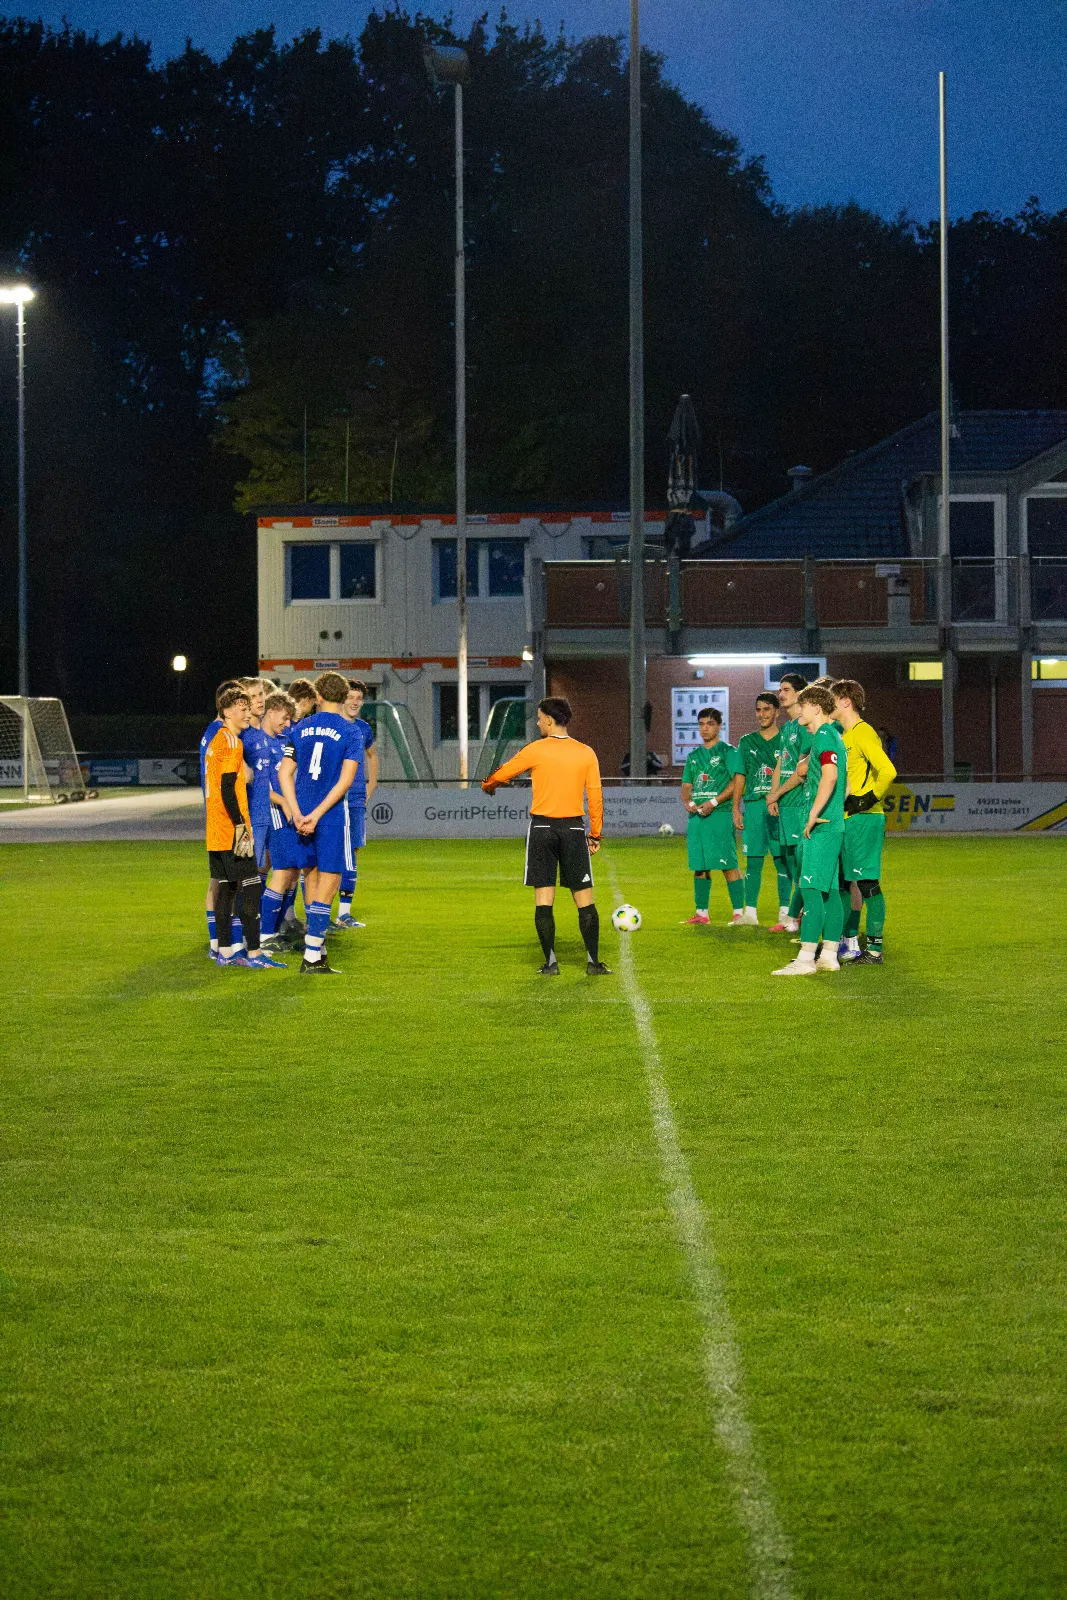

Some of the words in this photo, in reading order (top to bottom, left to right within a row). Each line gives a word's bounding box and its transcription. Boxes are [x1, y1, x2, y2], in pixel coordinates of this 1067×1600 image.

[309, 742, 324, 781] 4
[883, 795, 931, 812] SEN
[424, 805, 529, 821] GerritPfefferl
